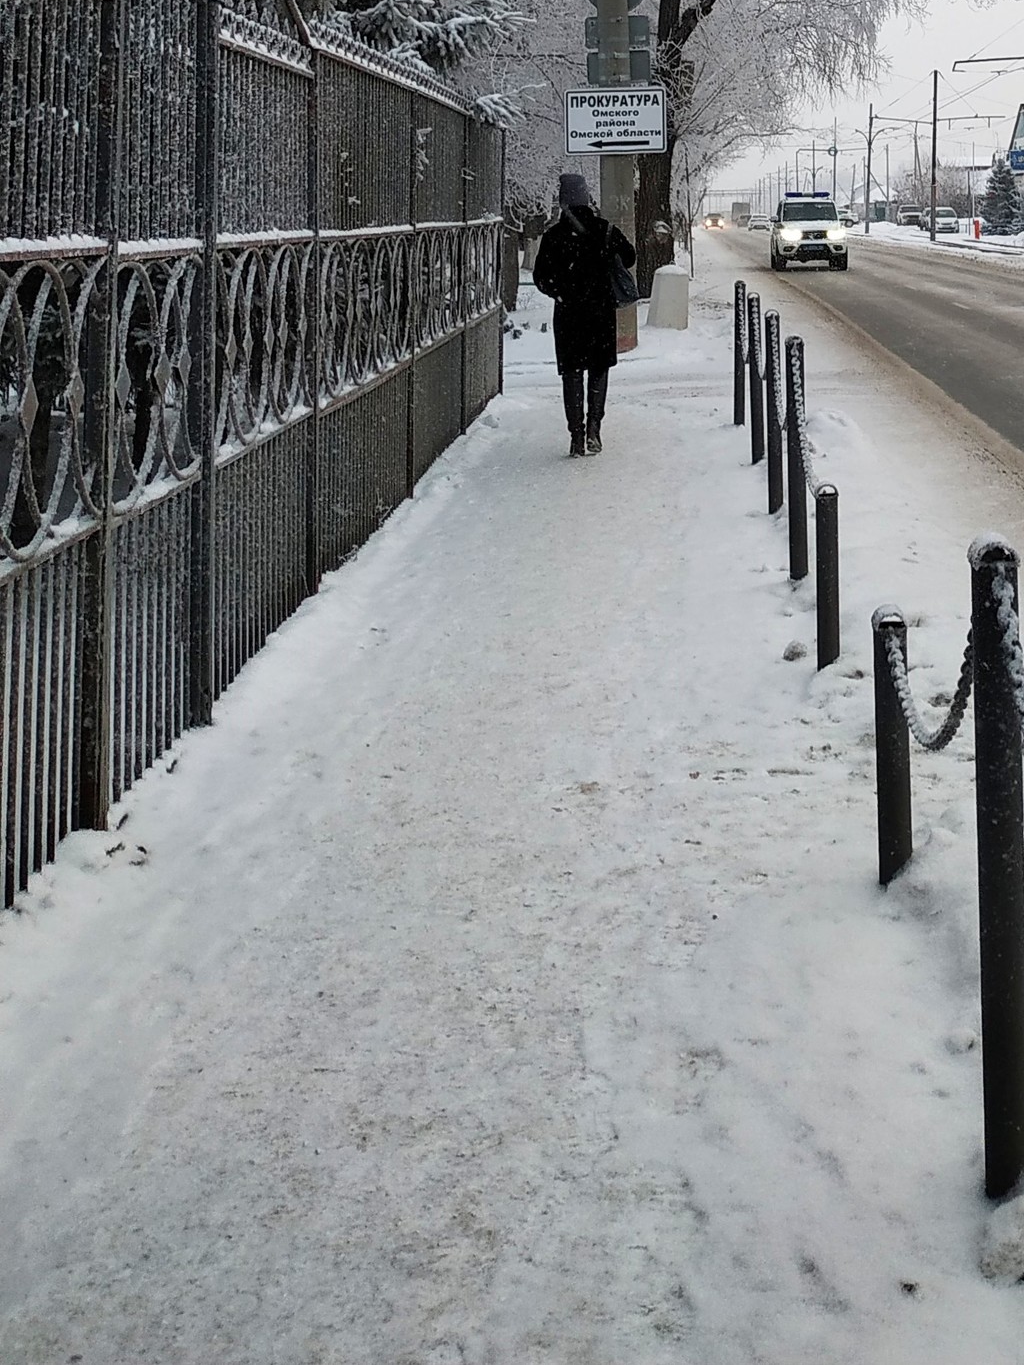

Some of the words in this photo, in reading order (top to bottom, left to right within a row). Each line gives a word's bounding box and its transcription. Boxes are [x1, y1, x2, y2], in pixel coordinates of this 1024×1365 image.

[570, 94, 660, 108] ПРОКУРАТУРА
[592, 109, 639, 117] Омского
[595, 119, 636, 129] района
[570, 129, 613, 138] Омской
[616, 128, 661, 137] области
